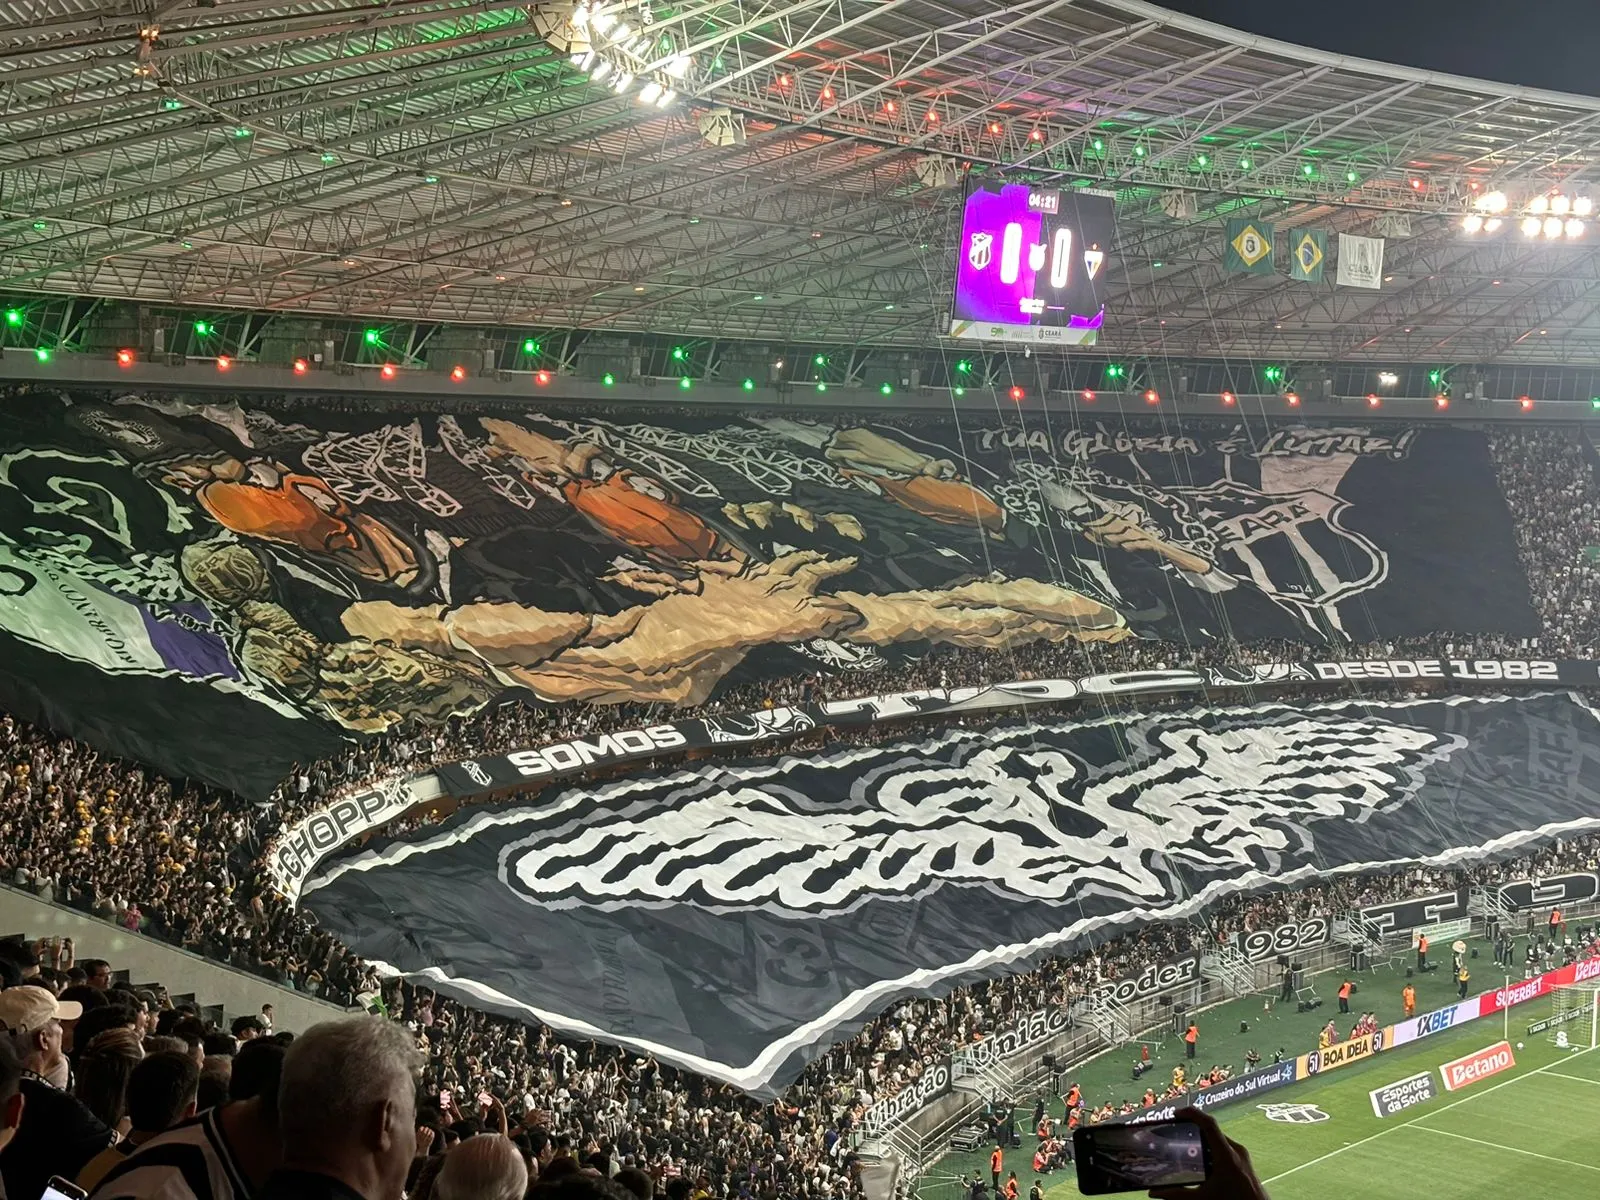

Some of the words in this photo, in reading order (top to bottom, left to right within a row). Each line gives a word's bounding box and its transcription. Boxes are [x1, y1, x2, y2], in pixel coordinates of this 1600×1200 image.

[1050, 228, 1072, 288] 0
[507, 725, 687, 776] SOMOS
[1313, 660, 1445, 680] DESDE
[1450, 660, 1559, 680] 1982
[1092, 958, 1196, 1011] Poder
[1574, 958, 1600, 982] Beta
[1495, 977, 1543, 1008] SUPERBET
[971, 1008, 1069, 1068] União
[1417, 1006, 1458, 1037] 1XBET
[1309, 1053, 1319, 1073] 51
[1323, 1051, 1344, 1067] BOA
[1346, 1039, 1368, 1059] IDEIA
[1373, 1033, 1383, 1051] 51
[1452, 1051, 1509, 1086] Betano
[865, 1064, 948, 1135] Vibração
[1205, 1087, 1234, 1105] Cruzeiro
[1235, 1083, 1245, 1095] do
[1245, 1080, 1257, 1093] Sul
[1257, 1072, 1281, 1089] Virtual
[1382, 1076, 1430, 1103] Esportes
